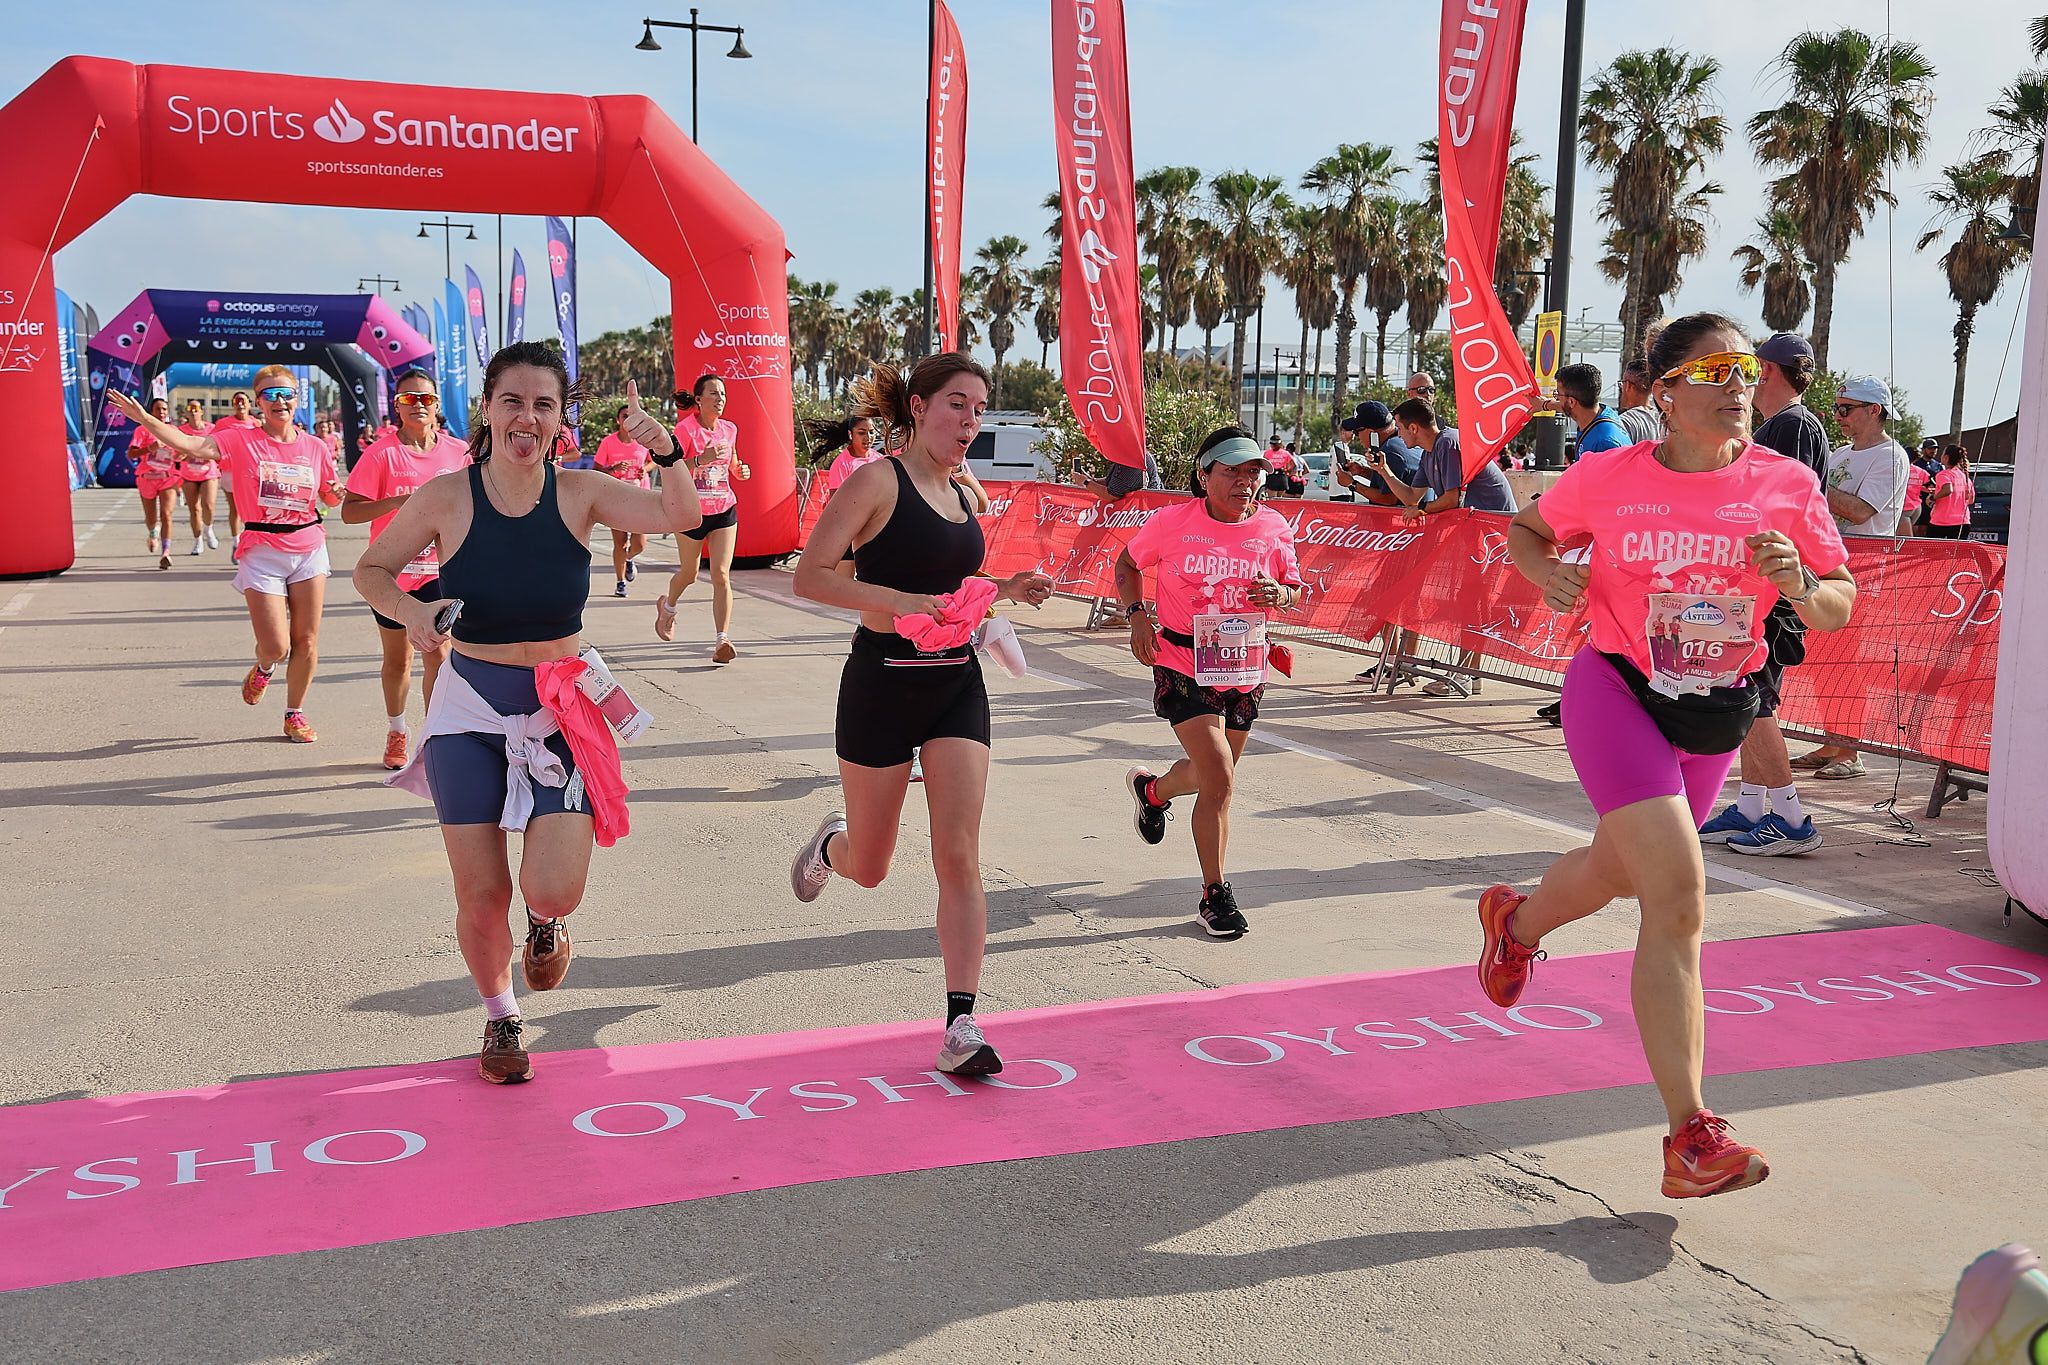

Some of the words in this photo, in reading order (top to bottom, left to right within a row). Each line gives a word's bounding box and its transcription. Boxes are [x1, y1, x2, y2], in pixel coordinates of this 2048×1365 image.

[167, 95, 305, 144] Sports
[372, 110, 579, 153] Santander
[307, 160, 444, 178] sportssantander.es
[223, 302, 275, 314] octopus
[276, 304, 319, 317] energy
[718, 303, 770, 323] Sports
[199, 317, 213, 325] LA
[257, 319, 284, 327] PARA
[285, 320, 323, 328] CORRER
[222, 328, 277, 336] VELOCIDAD
[714, 331, 787, 348] Santander
[1447, 255, 1532, 446] Sports
[278, 482, 299, 493] 016
[1033, 496, 1077, 526] Sports
[1616, 503, 1671, 517] OYSHO
[1182, 535, 1215, 545] OYSHO
[1295, 517, 1425, 553] Santander
[1660, 601, 1682, 610] SUMA
[1220, 646, 1248, 659] 016
[1682, 640, 1723, 659] 016
[1688, 659, 1705, 668] 440
[1690, 669, 1712, 678] MUJER
[1702, 964, 2043, 1017] OYSHO
[1183, 1003, 1604, 1066] OYSHO
[573, 1058, 1077, 1138] OYSHO
